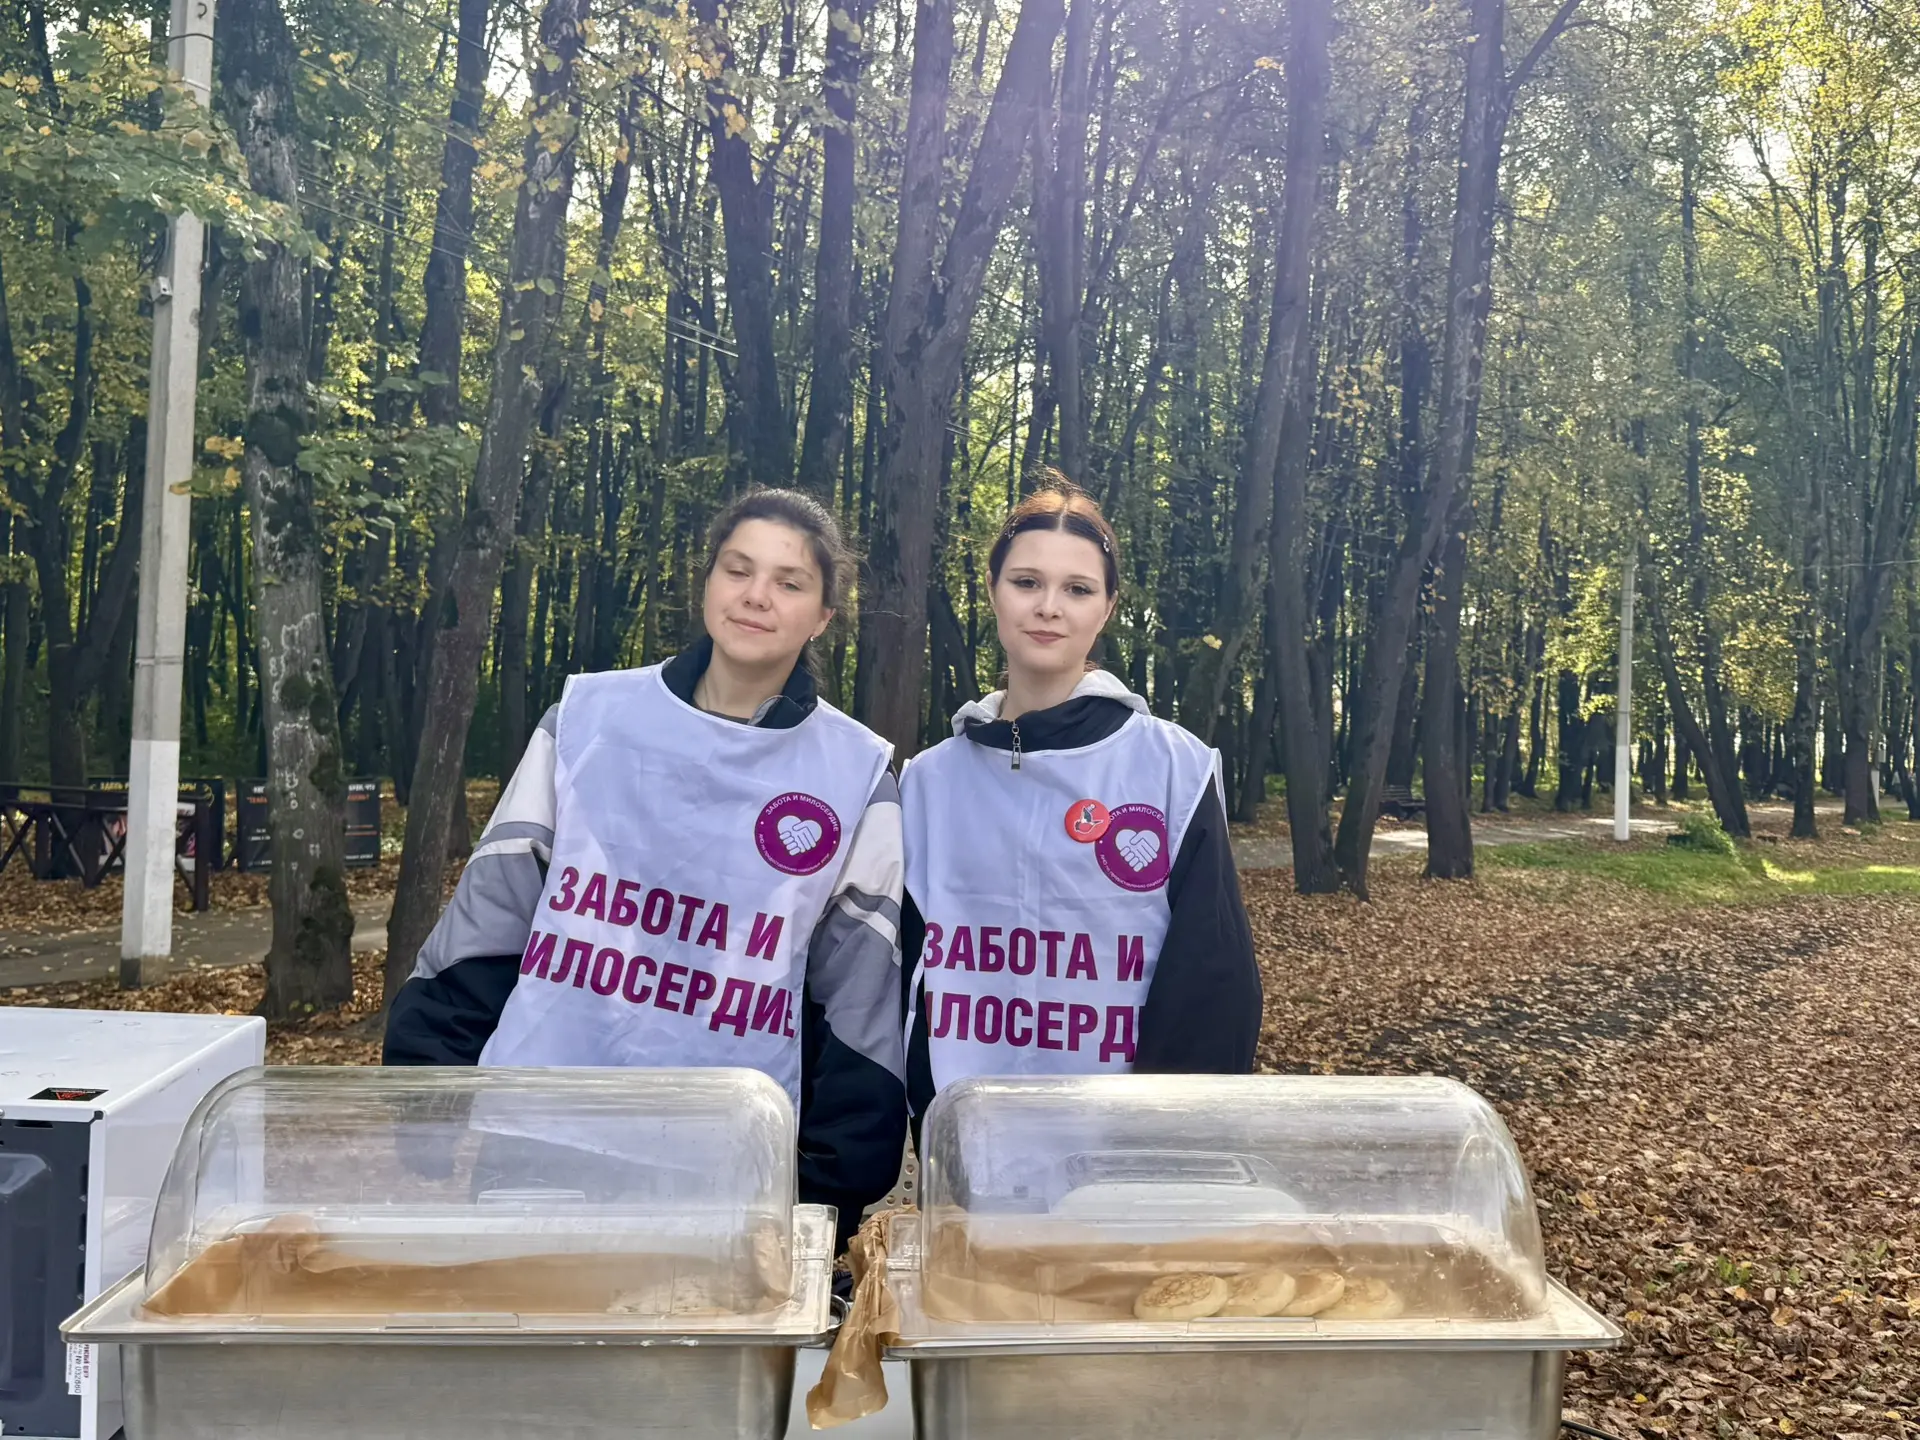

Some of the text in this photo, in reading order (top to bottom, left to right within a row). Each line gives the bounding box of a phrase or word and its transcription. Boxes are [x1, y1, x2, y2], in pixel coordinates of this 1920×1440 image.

[765, 795, 792, 815] ЗАБОТА
[799, 795, 839, 832] МИЛОСЕРДИЕ
[1128, 806, 1166, 828] МИЛОСЕР
[549, 866, 785, 961] ЗАБОТА И
[924, 921, 1144, 981] ЗАБОТА И
[520, 930, 796, 1039] ИЛОСЕРДИЕ
[924, 990, 1136, 1063] ЛОСЕРД
